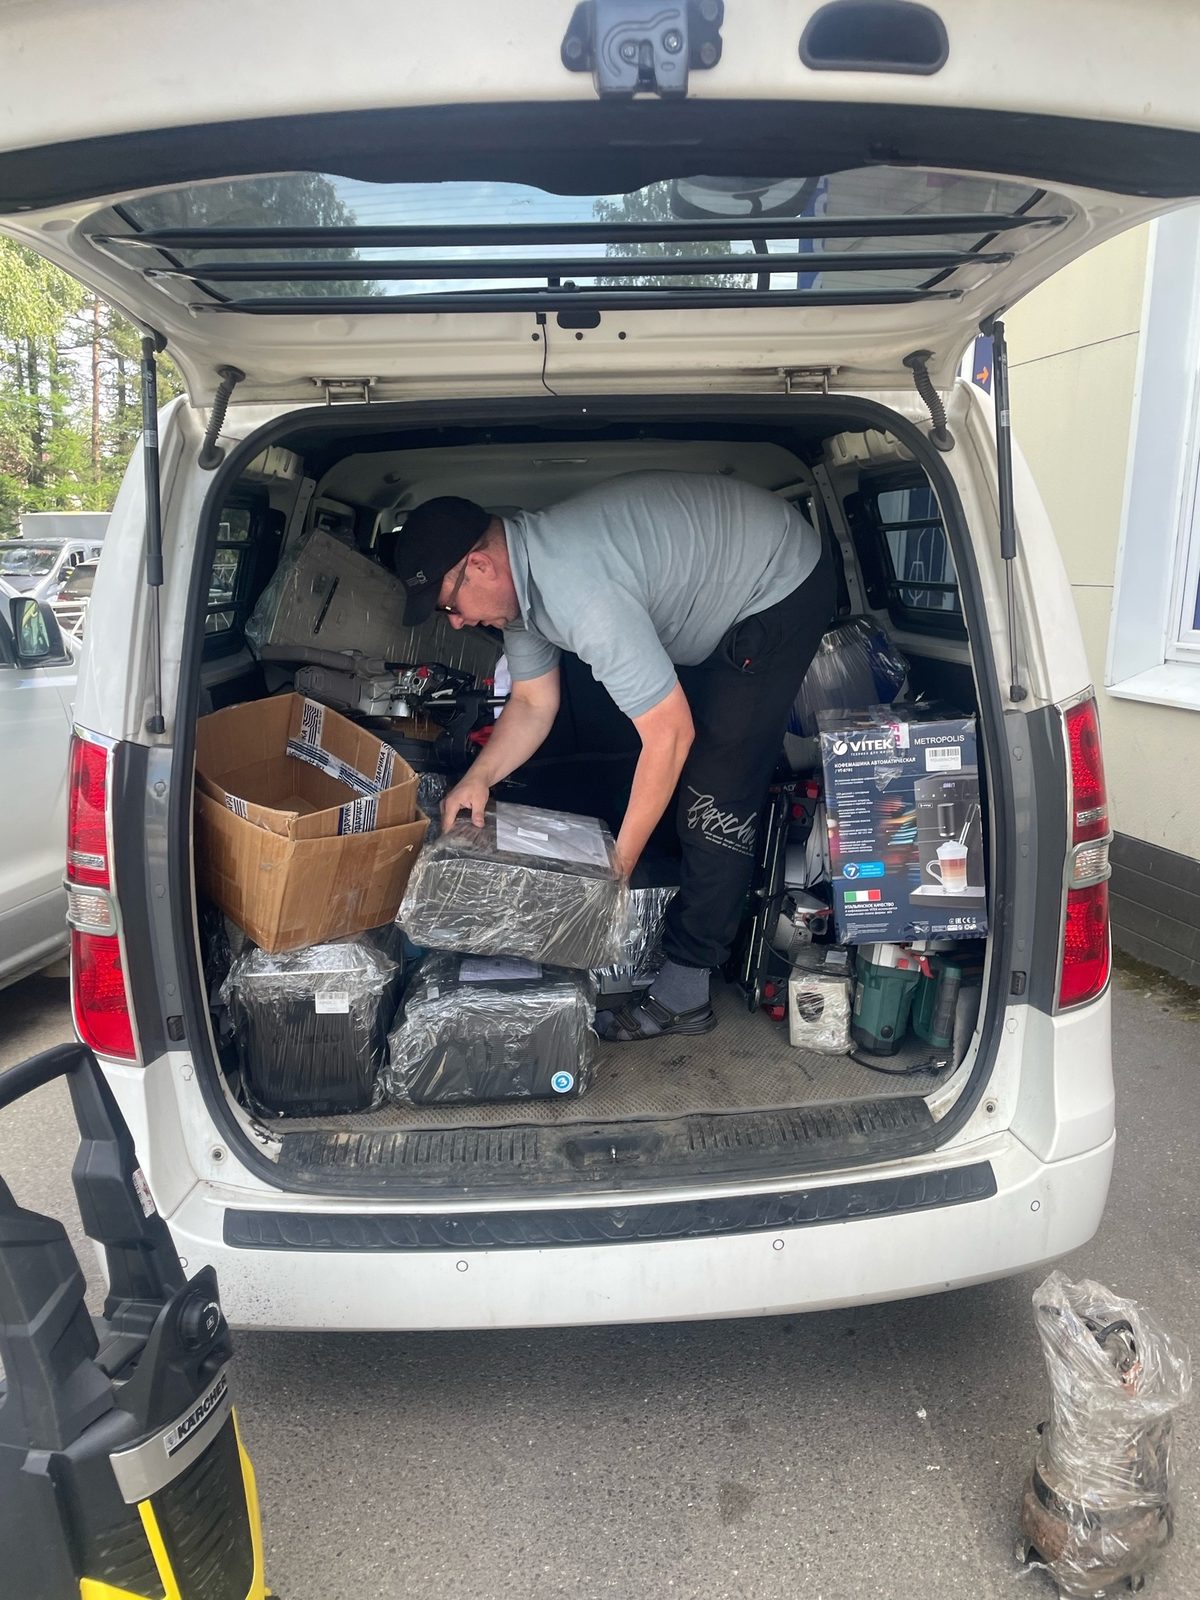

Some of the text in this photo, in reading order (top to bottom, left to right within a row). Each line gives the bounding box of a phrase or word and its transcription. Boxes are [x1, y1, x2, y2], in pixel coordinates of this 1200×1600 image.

[914, 734, 965, 745] METROPOLIS
[850, 739, 894, 752] VITEK
[834, 761, 871, 769] КОФЕМАШИНА
[847, 867, 856, 877] 7
